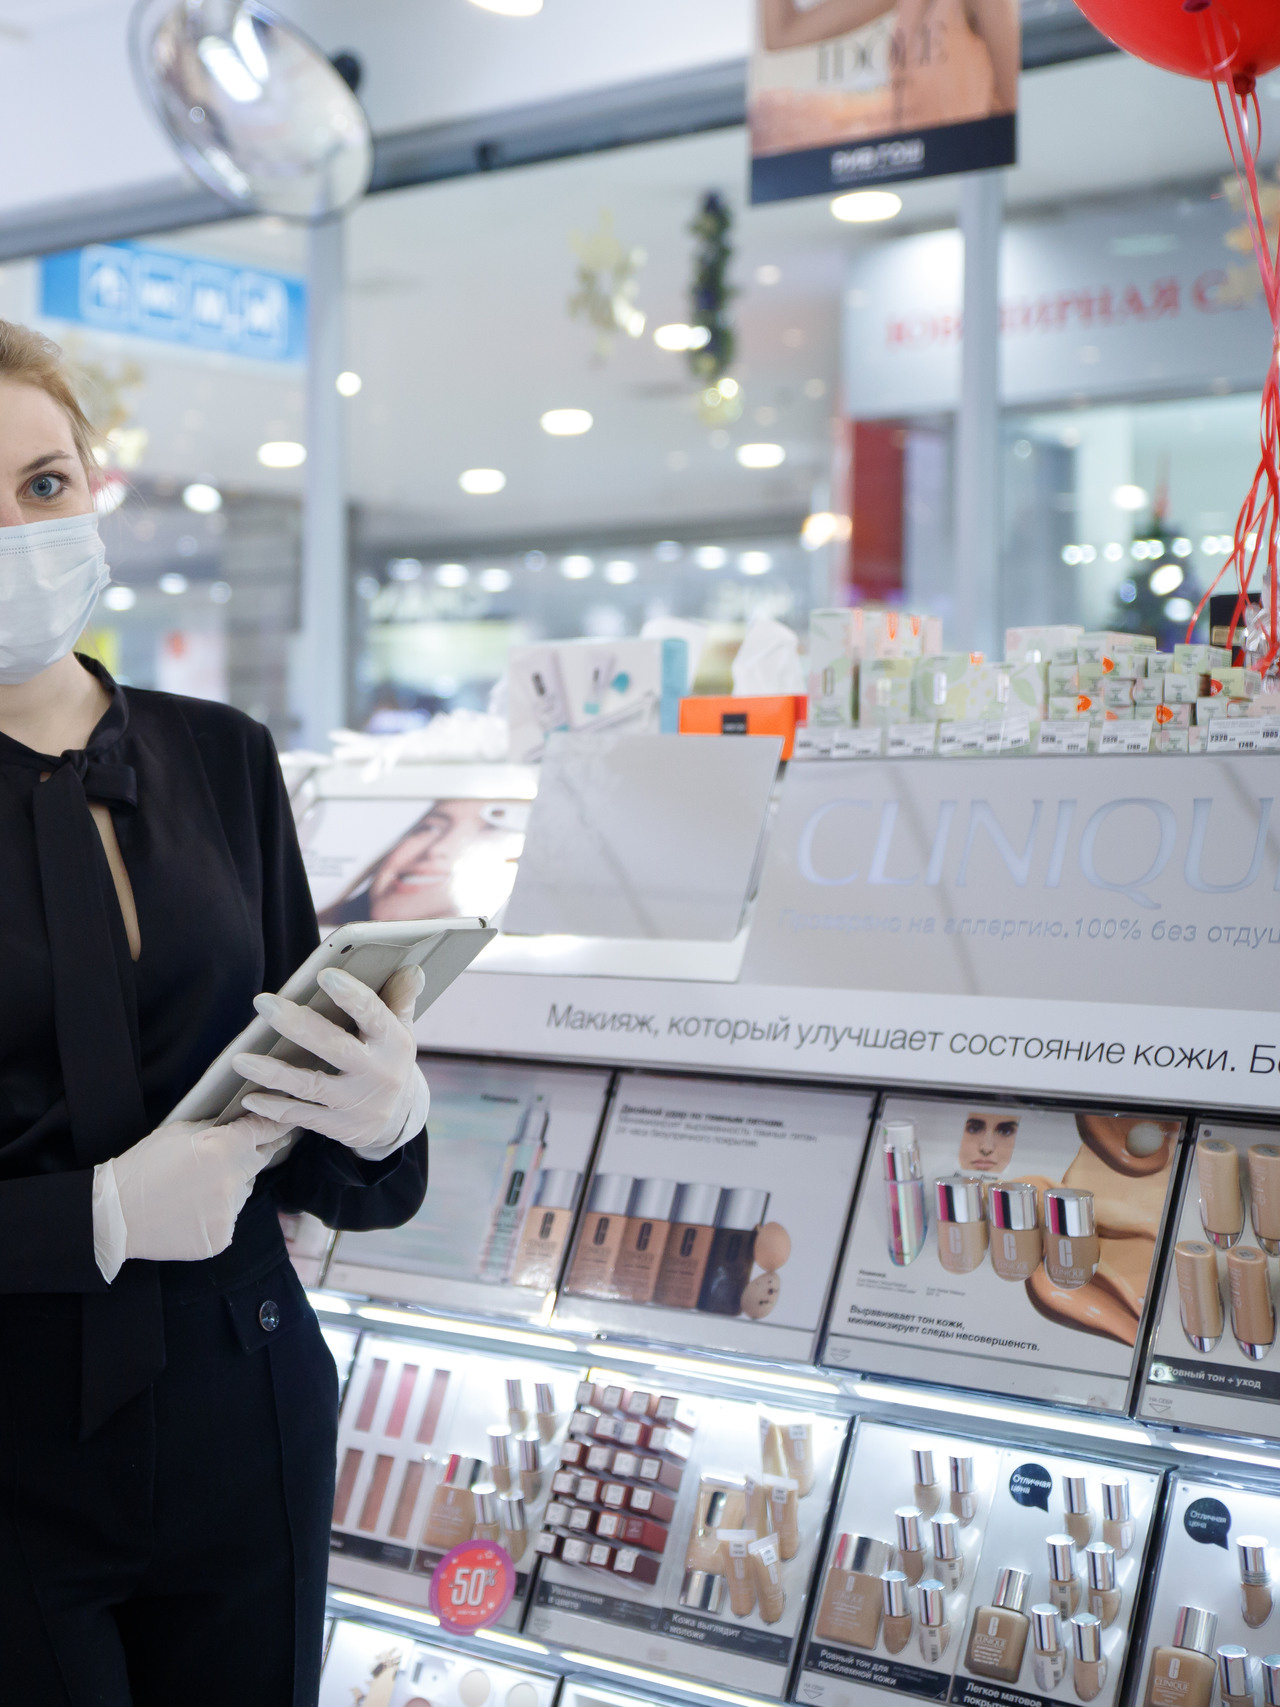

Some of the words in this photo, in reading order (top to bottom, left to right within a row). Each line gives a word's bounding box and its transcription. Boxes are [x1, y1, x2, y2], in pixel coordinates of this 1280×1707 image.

[796, 797, 1280, 910] CLINIQU
[907, 916, 936, 935] на
[1151, 920, 1197, 942] без
[546, 1003, 659, 1038] Макияж,
[667, 1016, 790, 1045] который
[793, 1023, 944, 1053] улучшает
[949, 1032, 1125, 1065] состояние
[1133, 1044, 1236, 1073] кожи.
[850, 1304, 916, 1321] Выравнивает
[917, 1315, 935, 1325] тон
[935, 1318, 966, 1331] кожи,
[847, 1316, 920, 1334] минимизирует
[921, 1327, 954, 1339] следы
[955, 1332, 1040, 1351] несовершенств.
[1167, 1366, 1206, 1381] Ровный
[1207, 1373, 1225, 1383] тон
[1235, 1377, 1262, 1390] уход
[1012, 1473, 1052, 1489] Отличная
[1188, 1520, 1207, 1529] цена
[1189, 1510, 1227, 1523] Отличная
[671, 1613, 696, 1627] Кожа
[697, 1621, 742, 1638] выглядит
[817, 1660, 873, 1680] проблемной
[873, 1673, 897, 1686] кожи
[820, 1648, 855, 1665] Ровный
[855, 1659, 872, 1669] тон
[872, 1663, 890, 1673] для
[965, 1681, 1000, 1698] Легкое
[1000, 1691, 1042, 1707] матовое
